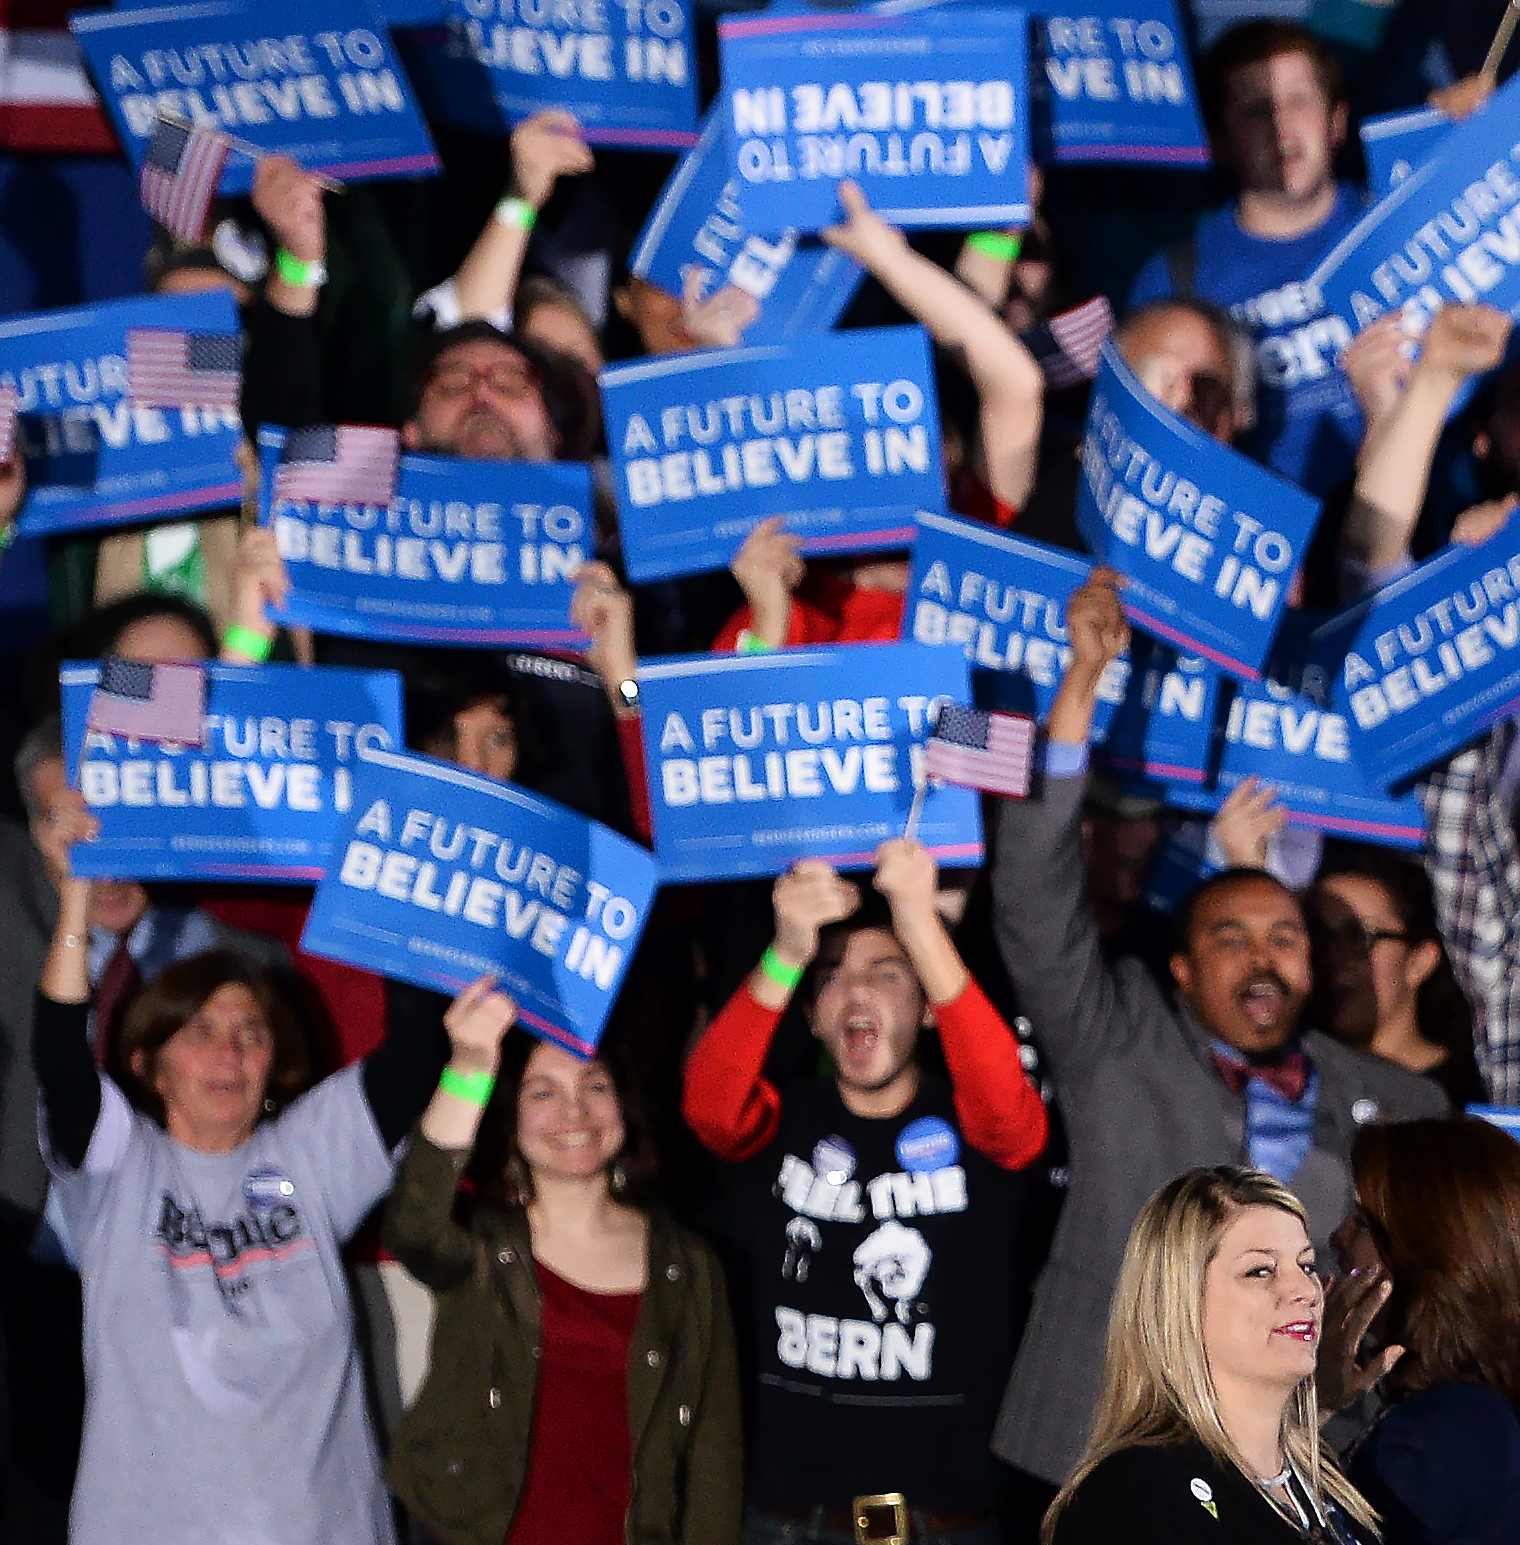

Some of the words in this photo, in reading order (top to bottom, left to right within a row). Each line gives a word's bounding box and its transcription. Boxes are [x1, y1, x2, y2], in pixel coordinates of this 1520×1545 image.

[110, 52, 141, 93] A
[143, 36, 303, 85] FUTURE
[312, 28, 384, 70] TO
[625, 40, 687, 86] IN
[1106, 17, 1174, 60] TO
[338, 72, 405, 115] IN
[792, 80, 1016, 132] BELIEVE
[1123, 60, 1186, 103] IN
[733, 87, 787, 137] IN
[738, 140, 793, 184] TO
[802, 134, 972, 179] FUTURE
[978, 134, 1014, 174] A
[623, 413, 660, 455] A
[660, 384, 847, 449] FUTURE
[850, 378, 925, 423] TO
[625, 431, 854, 507] BELIEVE
[865, 424, 931, 474] IN
[510, 502, 584, 545] TO
[1232, 508, 1294, 573] TO
[274, 516, 508, 585] BELIEVE
[921, 560, 953, 598] A
[1212, 553, 1281, 622] IN
[1342, 647, 1377, 693] A
[660, 711, 696, 753] A
[701, 695, 895, 746] FUTURE
[79, 760, 325, 812] BELIEVE
[660, 743, 898, 808] BELIEVE
[354, 799, 395, 840] A
[399, 808, 582, 913] FUTURE
[585, 878, 640, 944] TO
[338, 840, 571, 959] BELIEVE
[563, 928, 624, 992] IN
